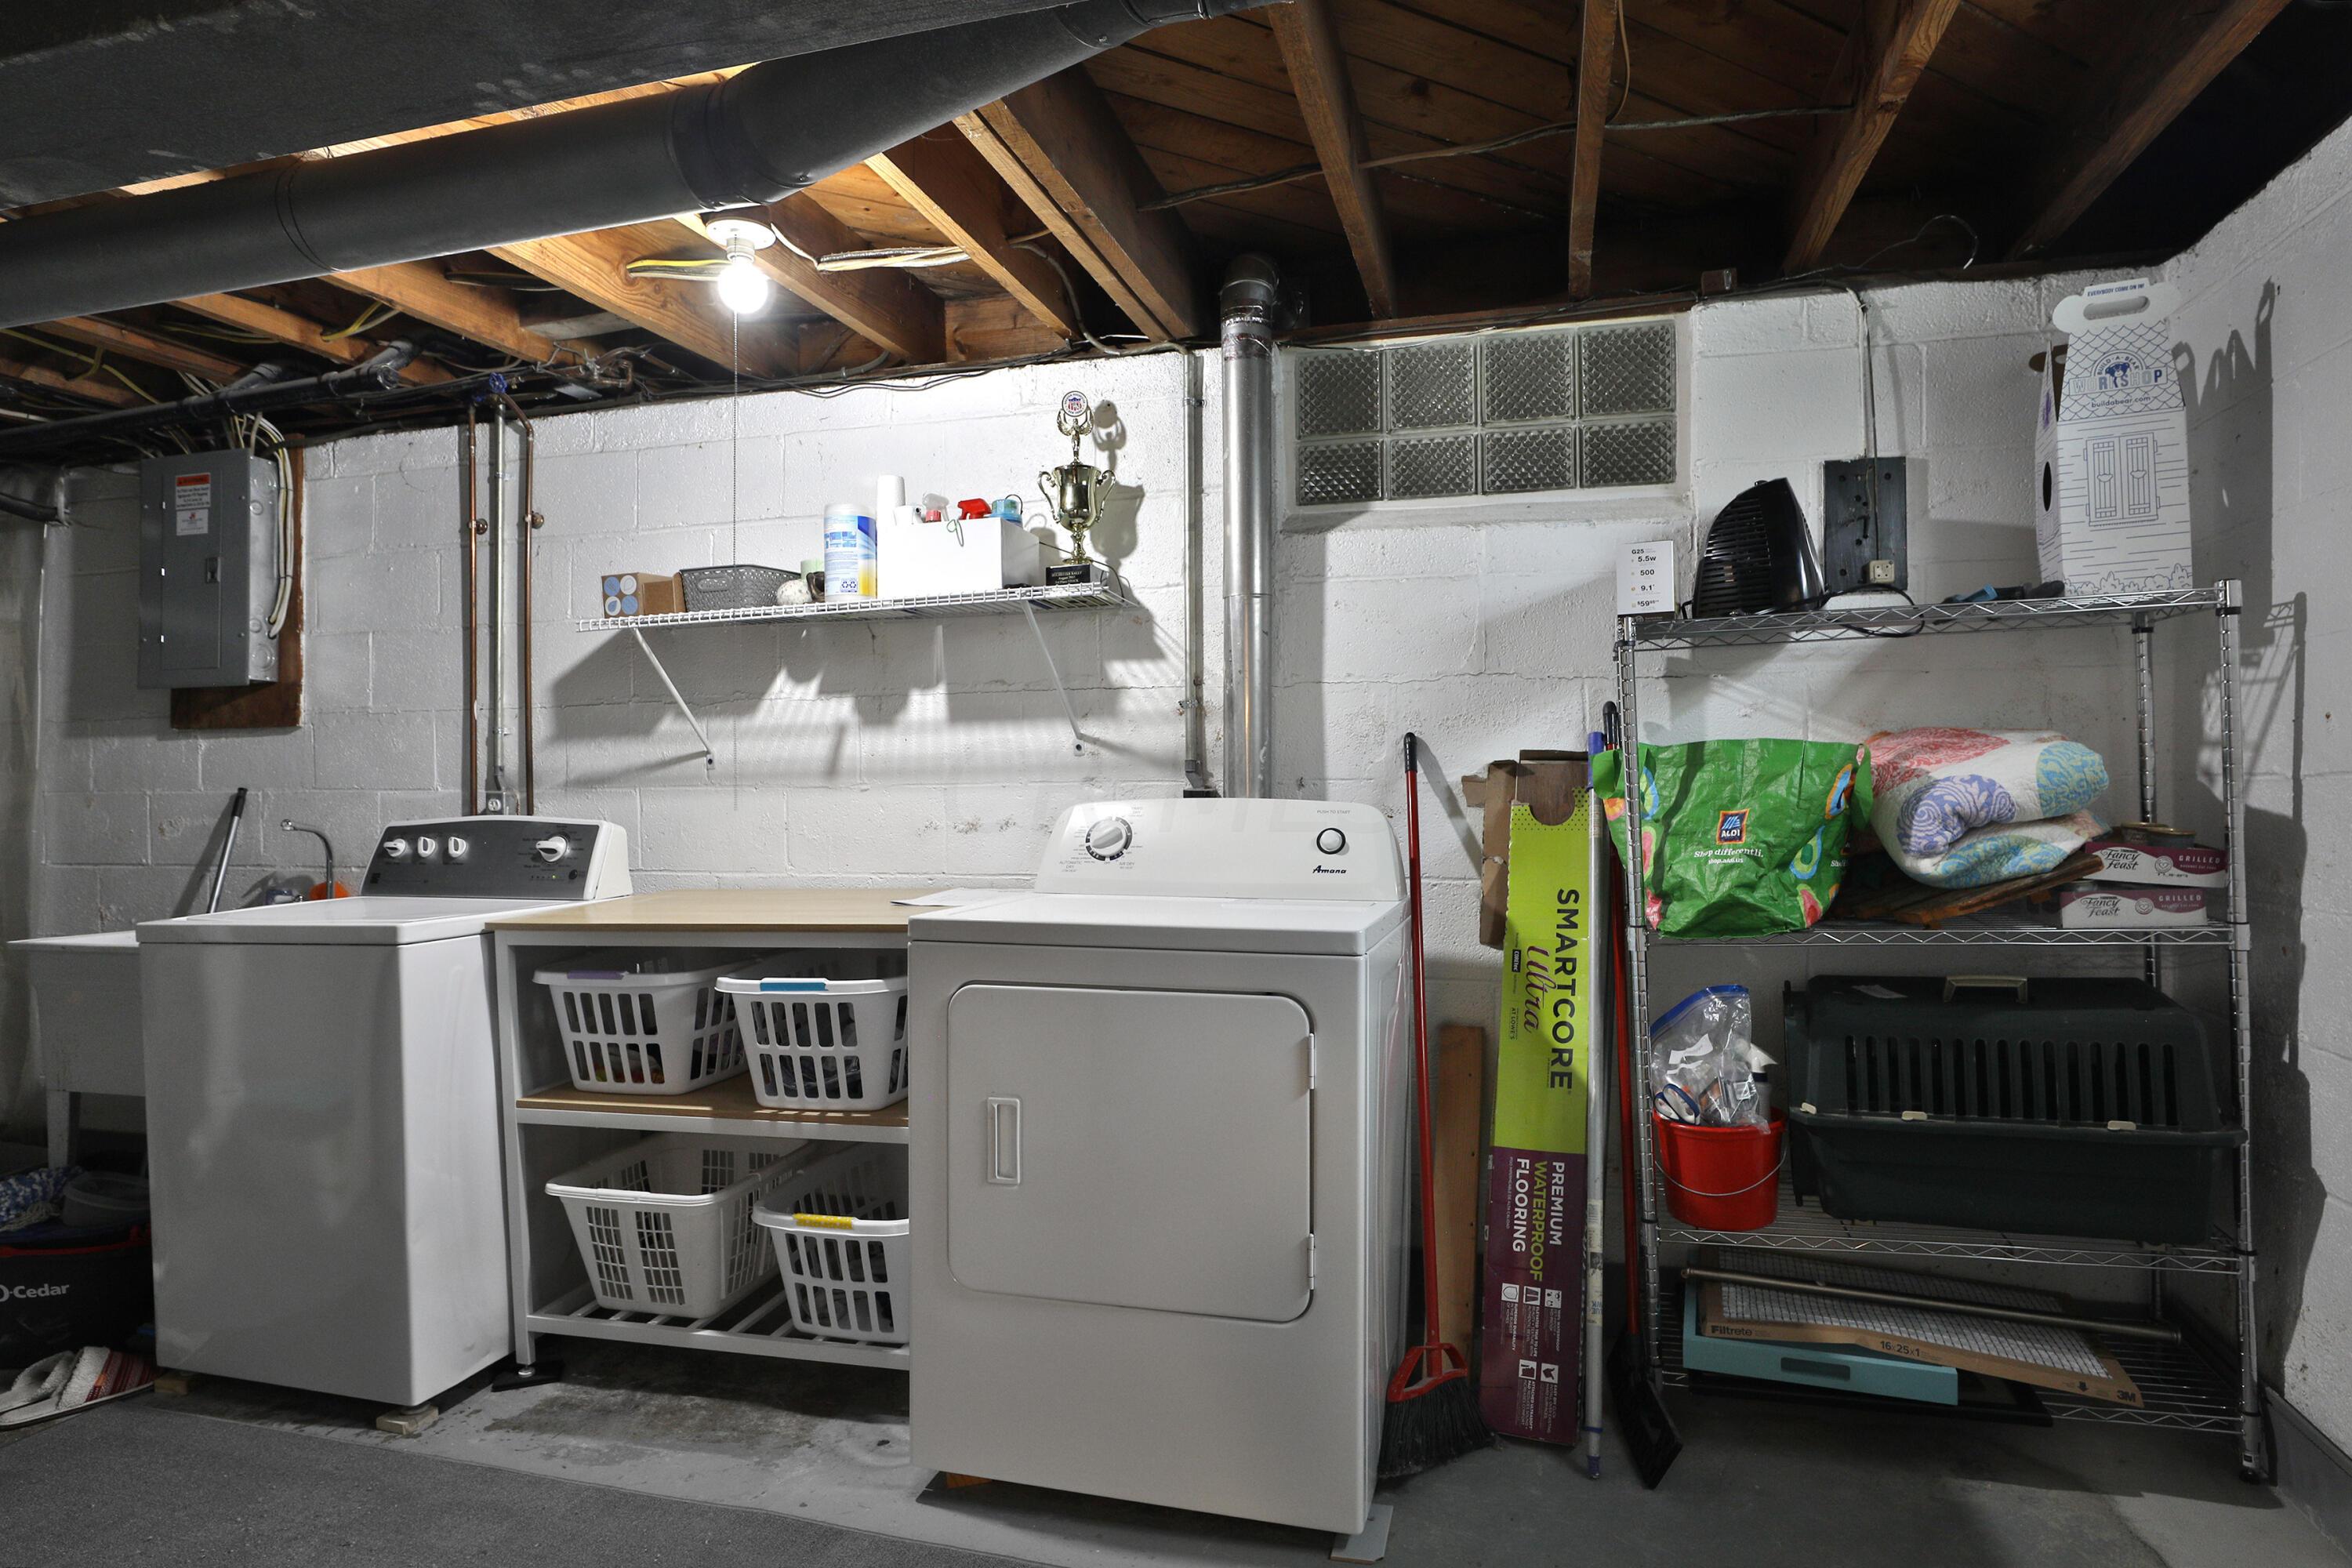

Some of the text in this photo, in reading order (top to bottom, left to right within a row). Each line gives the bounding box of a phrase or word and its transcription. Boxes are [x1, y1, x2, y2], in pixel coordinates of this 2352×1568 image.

[2088, 287, 2114, 296] EVERYBODY
[2074, 369, 2163, 393] WORKSHOP
[2091, 396, 2151, 408] buildabear.com
[1721, 829, 1740, 838] ALDI
[1714, 848, 1764, 858] differentli.
[2102, 849, 2140, 863] Fancy
[2178, 855, 2221, 864] GRILLED
[1312, 864, 1347, 874] Amana
[2107, 858, 2139, 871] Feast
[2082, 896, 2122, 909] Fancy
[2087, 906, 2120, 918] Feast
[1523, 946, 1558, 1036] Ultra
[1550, 888, 1581, 1091] SMARTCORE
[1512, 1158, 1530, 1252] FLOORING
[1549, 1161, 1566, 1245] PREMIUM
[1530, 1160, 1548, 1282] WATERPROOF
[1711, 1325, 1752, 1337] Filtrete
[2117, 1388, 2136, 1403] 3M
